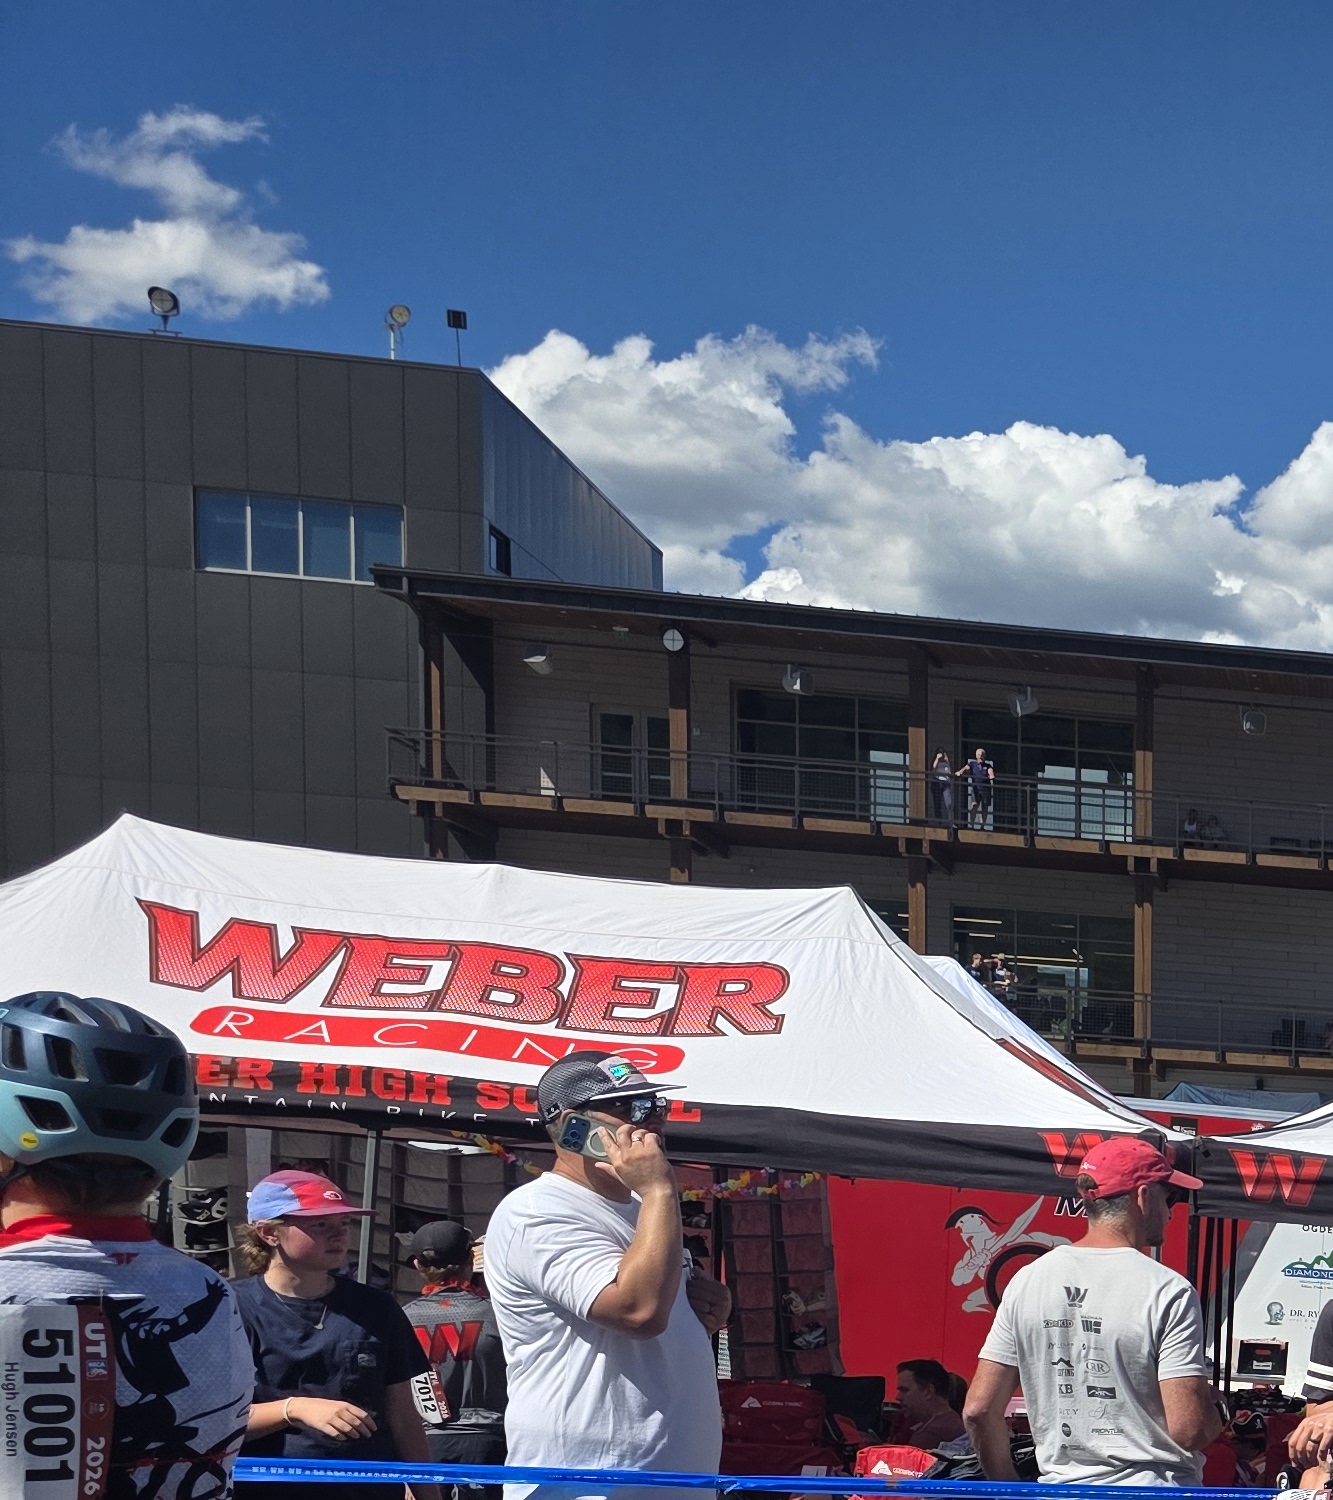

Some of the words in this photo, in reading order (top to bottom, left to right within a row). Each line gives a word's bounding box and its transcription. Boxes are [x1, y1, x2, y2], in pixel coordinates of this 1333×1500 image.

[136, 897, 789, 1037] WEBER
[297, 1063, 452, 1106] HIGH
[1228, 1149, 1327, 1206] W
[1308, 1310, 1320, 1318] RY
[1, 1362, 19, 1400] Hugh
[22, 1328, 77, 1482] 51001
[414, 1377, 437, 1413] 7012
[6, 1405, 20, 1457] Jensen
[84, 1436, 106, 1496] 2026
